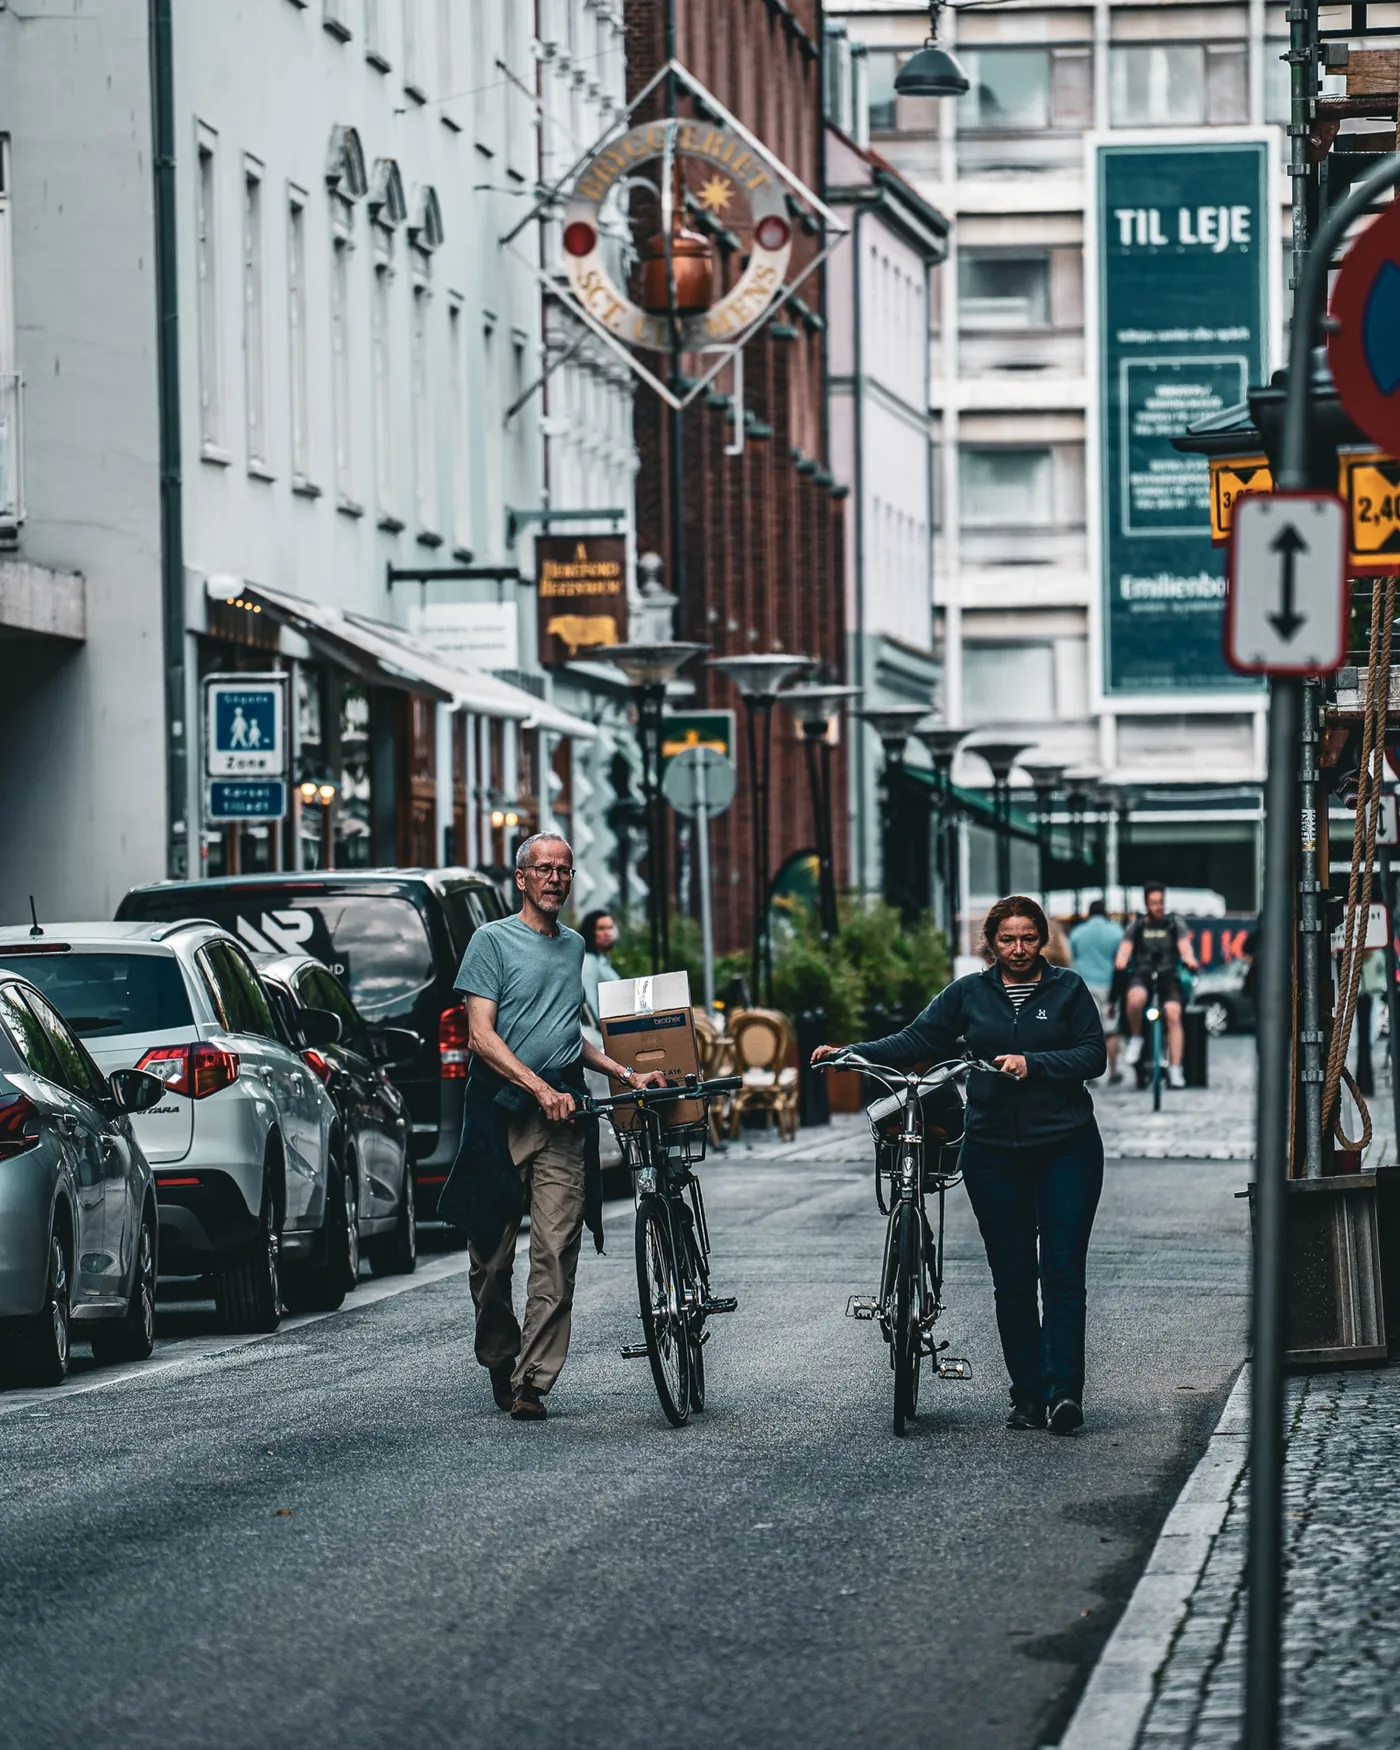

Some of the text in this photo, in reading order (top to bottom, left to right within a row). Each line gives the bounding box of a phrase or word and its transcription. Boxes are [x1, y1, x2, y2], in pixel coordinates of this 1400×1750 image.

[578, 125, 772, 200] BRYGGERIET
[1114, 205, 1252, 253] TIL LEJE
[578, 264, 777, 346] SCT. CLMENS
[226, 756, 267, 770] Zone
[653, 1016, 681, 1026] brother
[667, 1068, 682, 1077] A16
